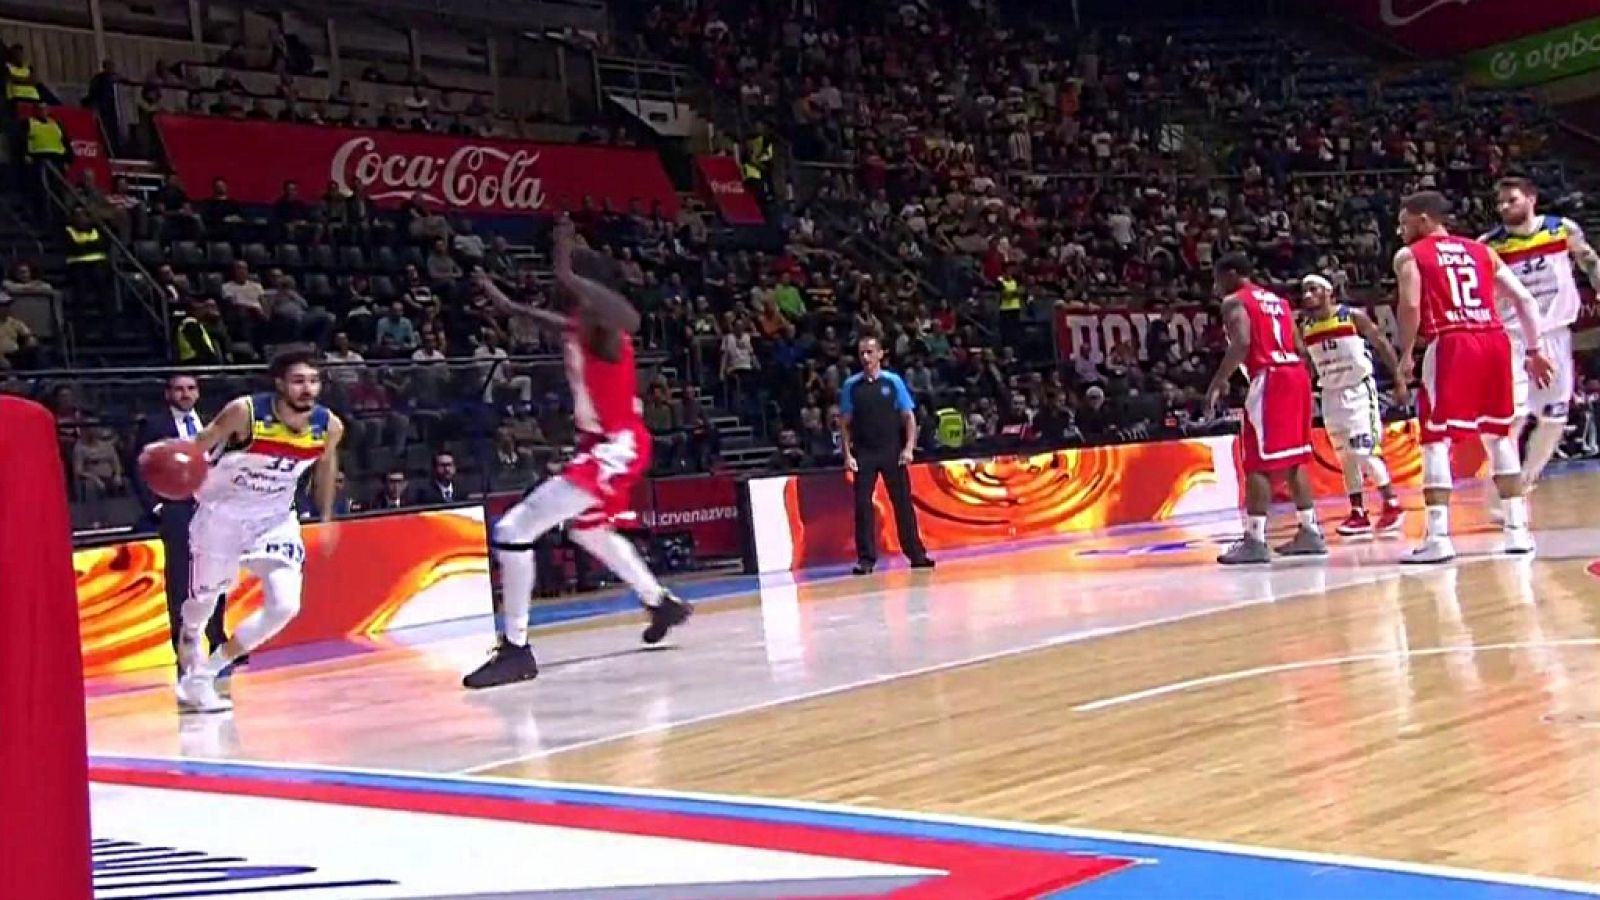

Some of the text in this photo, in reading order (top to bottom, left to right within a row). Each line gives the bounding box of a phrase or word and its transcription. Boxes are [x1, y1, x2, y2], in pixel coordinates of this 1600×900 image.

[330, 136, 546, 209] Coca-Cola
[1521, 255, 1547, 275] 32
[1446, 267, 1482, 307] 12
[264, 456, 299, 472] 33
